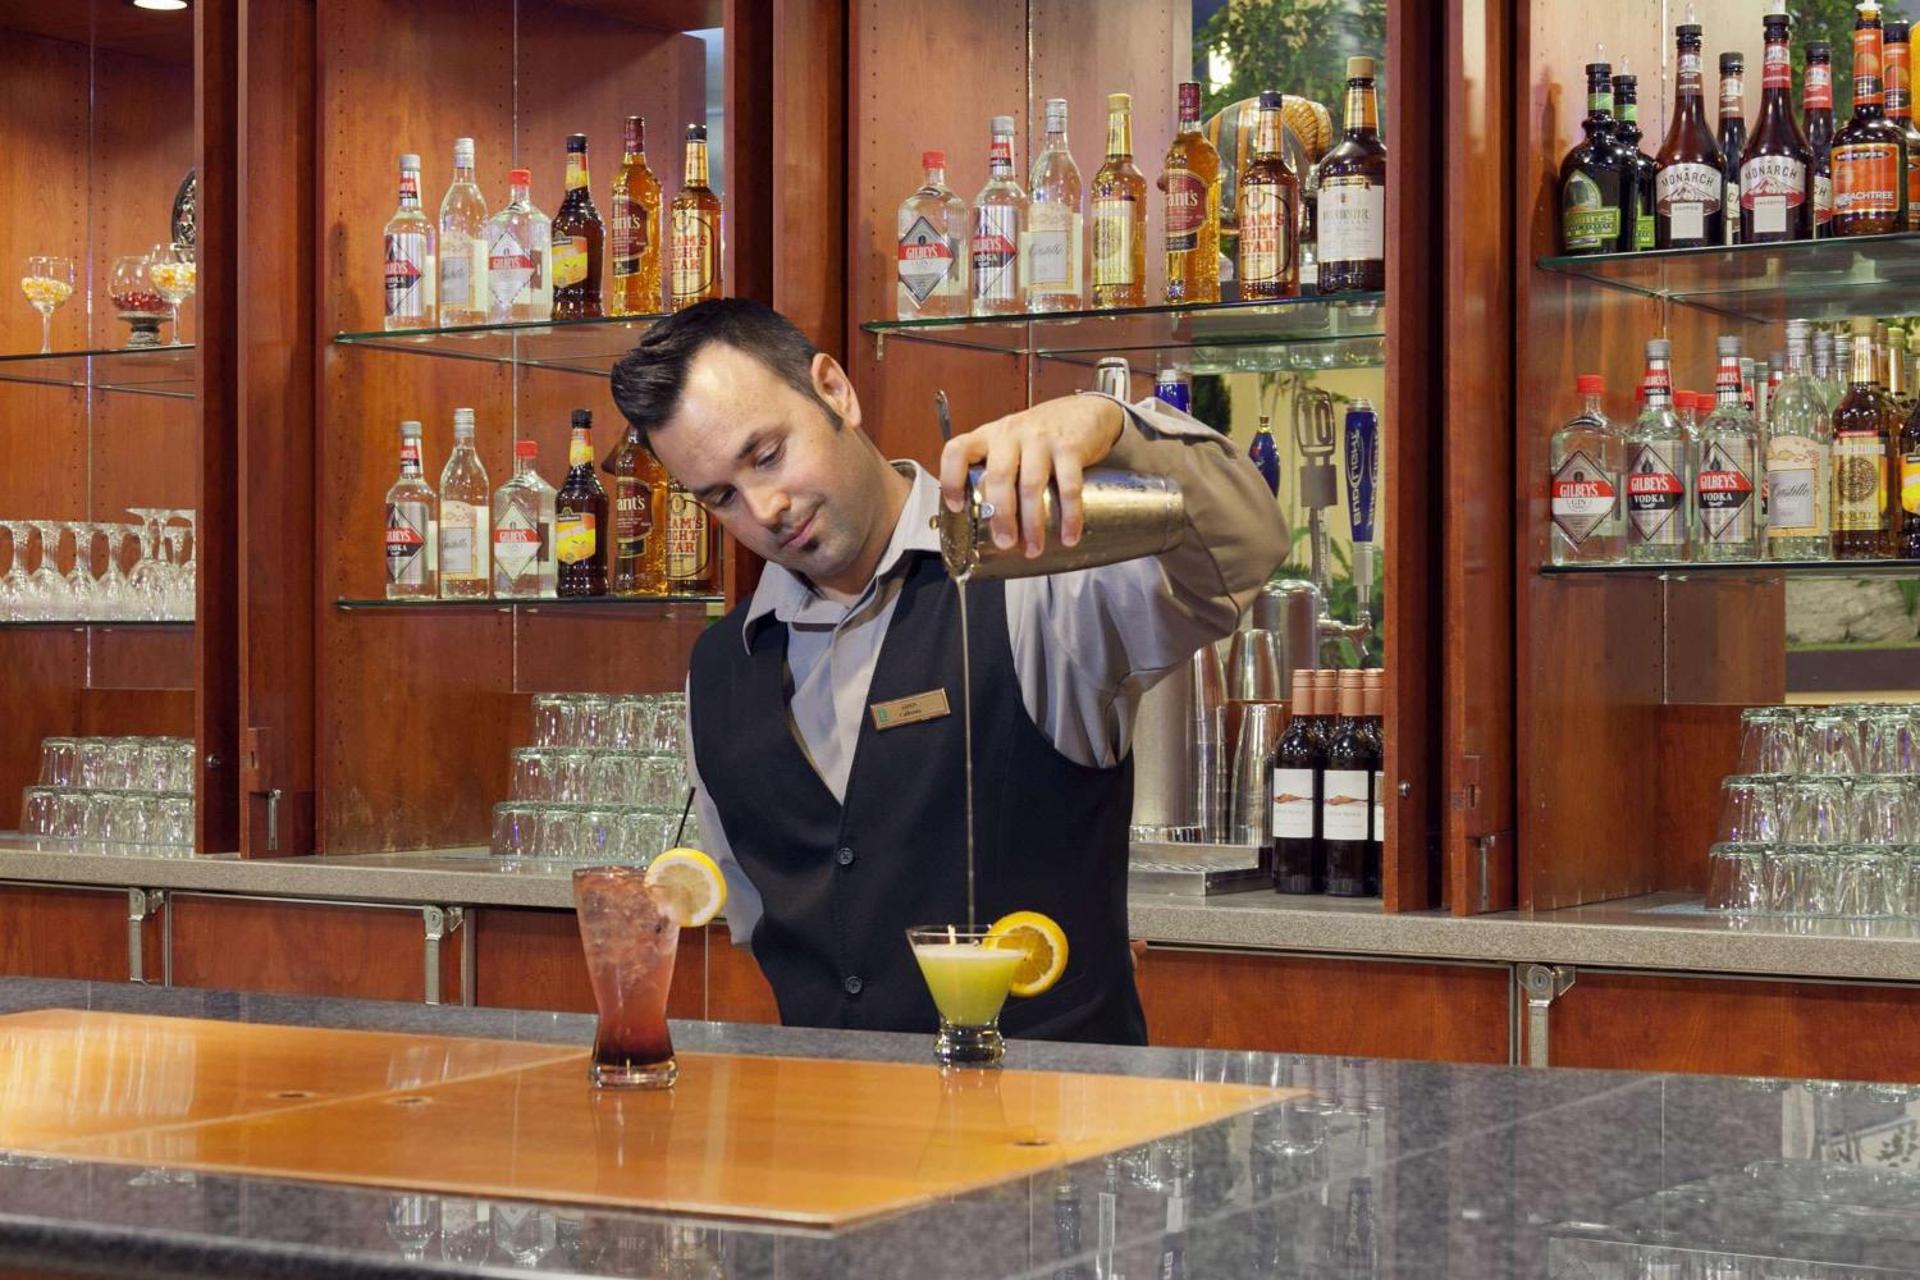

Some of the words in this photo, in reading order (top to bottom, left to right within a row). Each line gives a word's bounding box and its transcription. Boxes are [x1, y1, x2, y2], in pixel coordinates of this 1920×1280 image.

[1661, 172, 1716, 187] MONARCH
[1744, 164, 1798, 181] MONARCH
[1630, 474, 1670, 491] GILBEY'S
[1699, 472, 1738, 489] GILBEY'S
[1559, 481, 1599, 497] GILBEY'S
[1702, 491, 1734, 503] VODKA
[1633, 493, 1666, 503] VODKA
